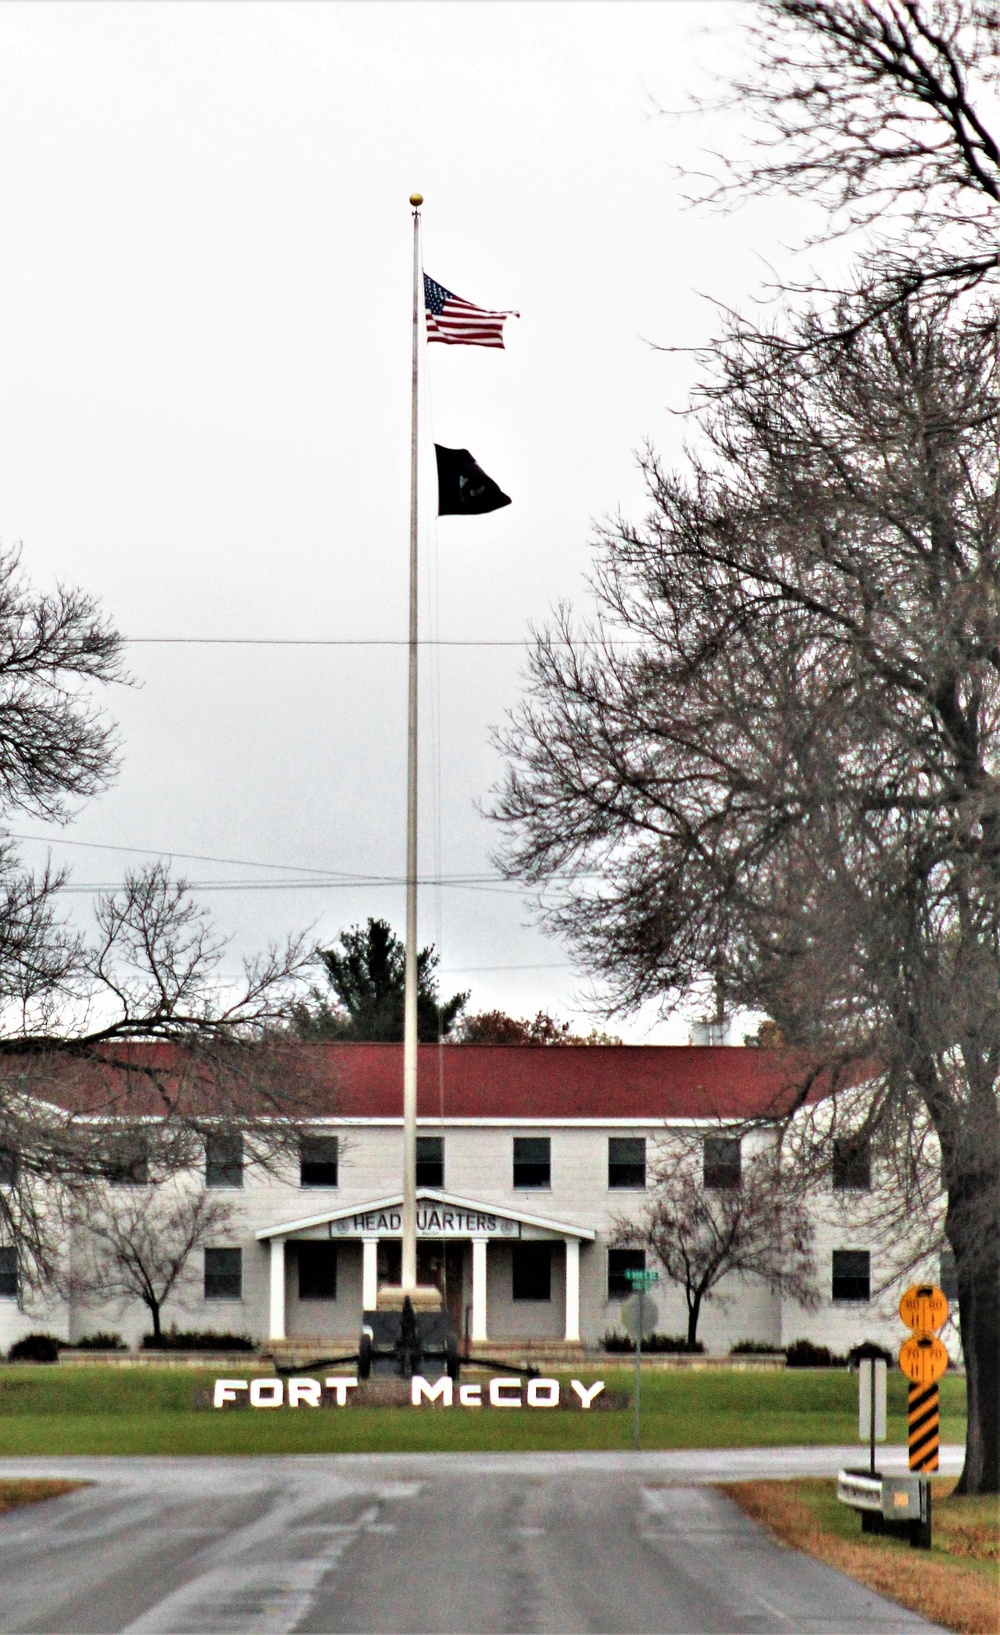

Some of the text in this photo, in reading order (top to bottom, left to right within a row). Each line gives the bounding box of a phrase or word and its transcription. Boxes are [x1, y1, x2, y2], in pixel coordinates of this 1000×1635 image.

[353, 1211, 497, 1231] HEADUARTERS
[213, 1376, 605, 1407] FORT McCOY
